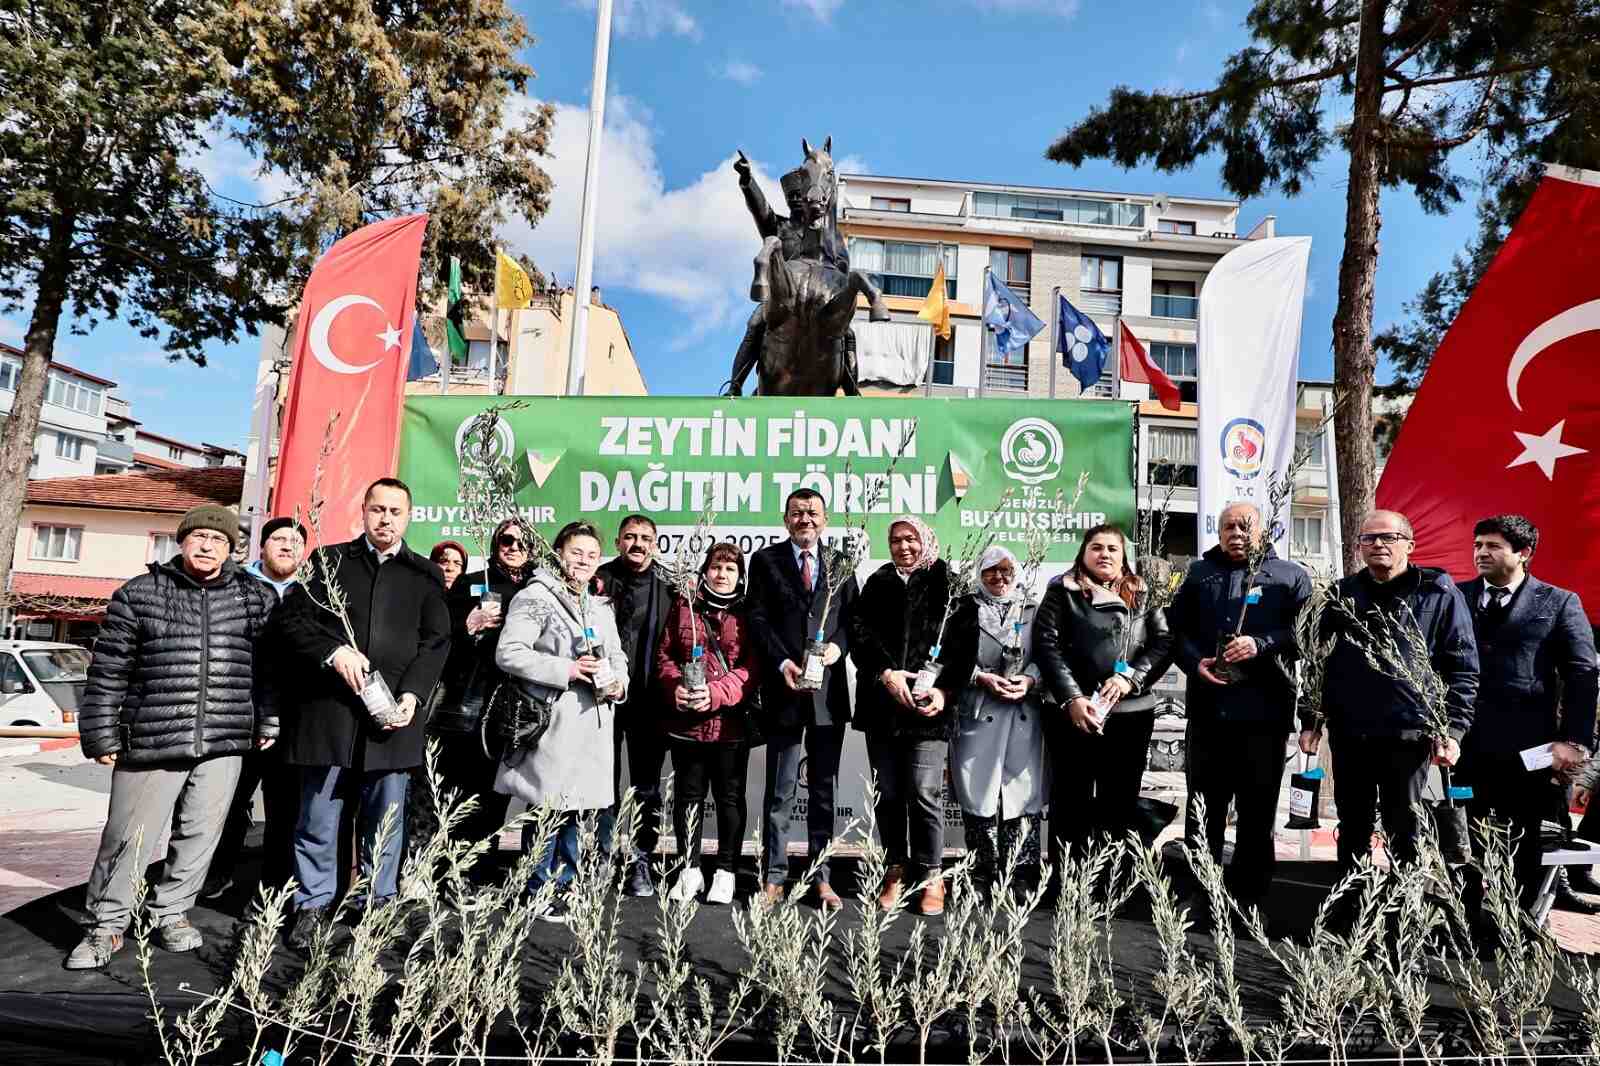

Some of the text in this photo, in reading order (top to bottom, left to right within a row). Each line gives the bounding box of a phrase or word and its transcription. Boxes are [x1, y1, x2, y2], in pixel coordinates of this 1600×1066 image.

[600, 410, 917, 458] ZEYTİN FİDANI
[580, 462, 937, 514] DAĞITIM TÖRENİ
